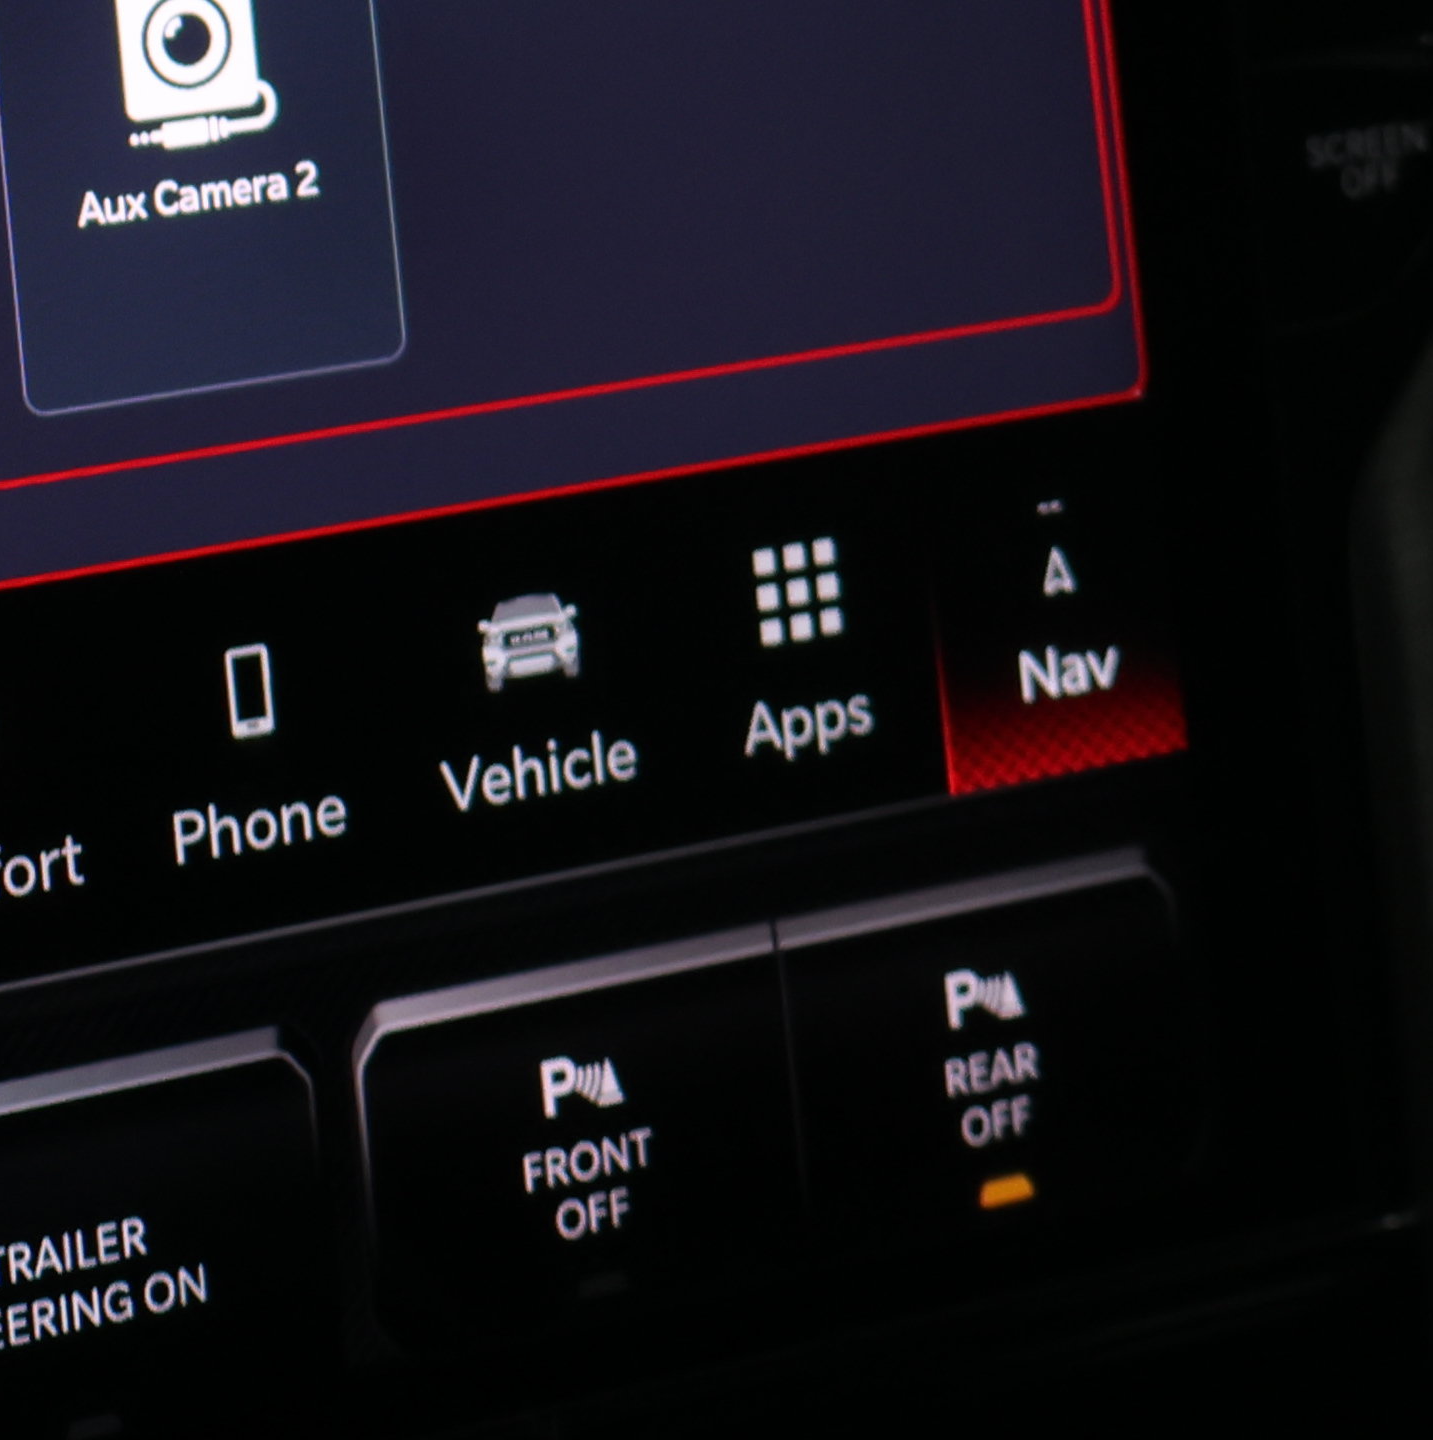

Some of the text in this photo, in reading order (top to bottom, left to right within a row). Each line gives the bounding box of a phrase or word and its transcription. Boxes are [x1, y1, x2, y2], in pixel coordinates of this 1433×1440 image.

[77, 159, 321, 229] Aux Camera 2
[1018, 645, 1119, 704] Nav
[744, 694, 873, 761] Apps
[439, 730, 637, 811] Vehicle
[172, 795, 347, 866] Phone
[944, 1042, 1039, 1098] REAR
[961, 1096, 1031, 1148] OFF
[522, 1126, 652, 1193] FRONT
[555, 1187, 629, 1240] OFF
[143, 1263, 208, 1313] ON
